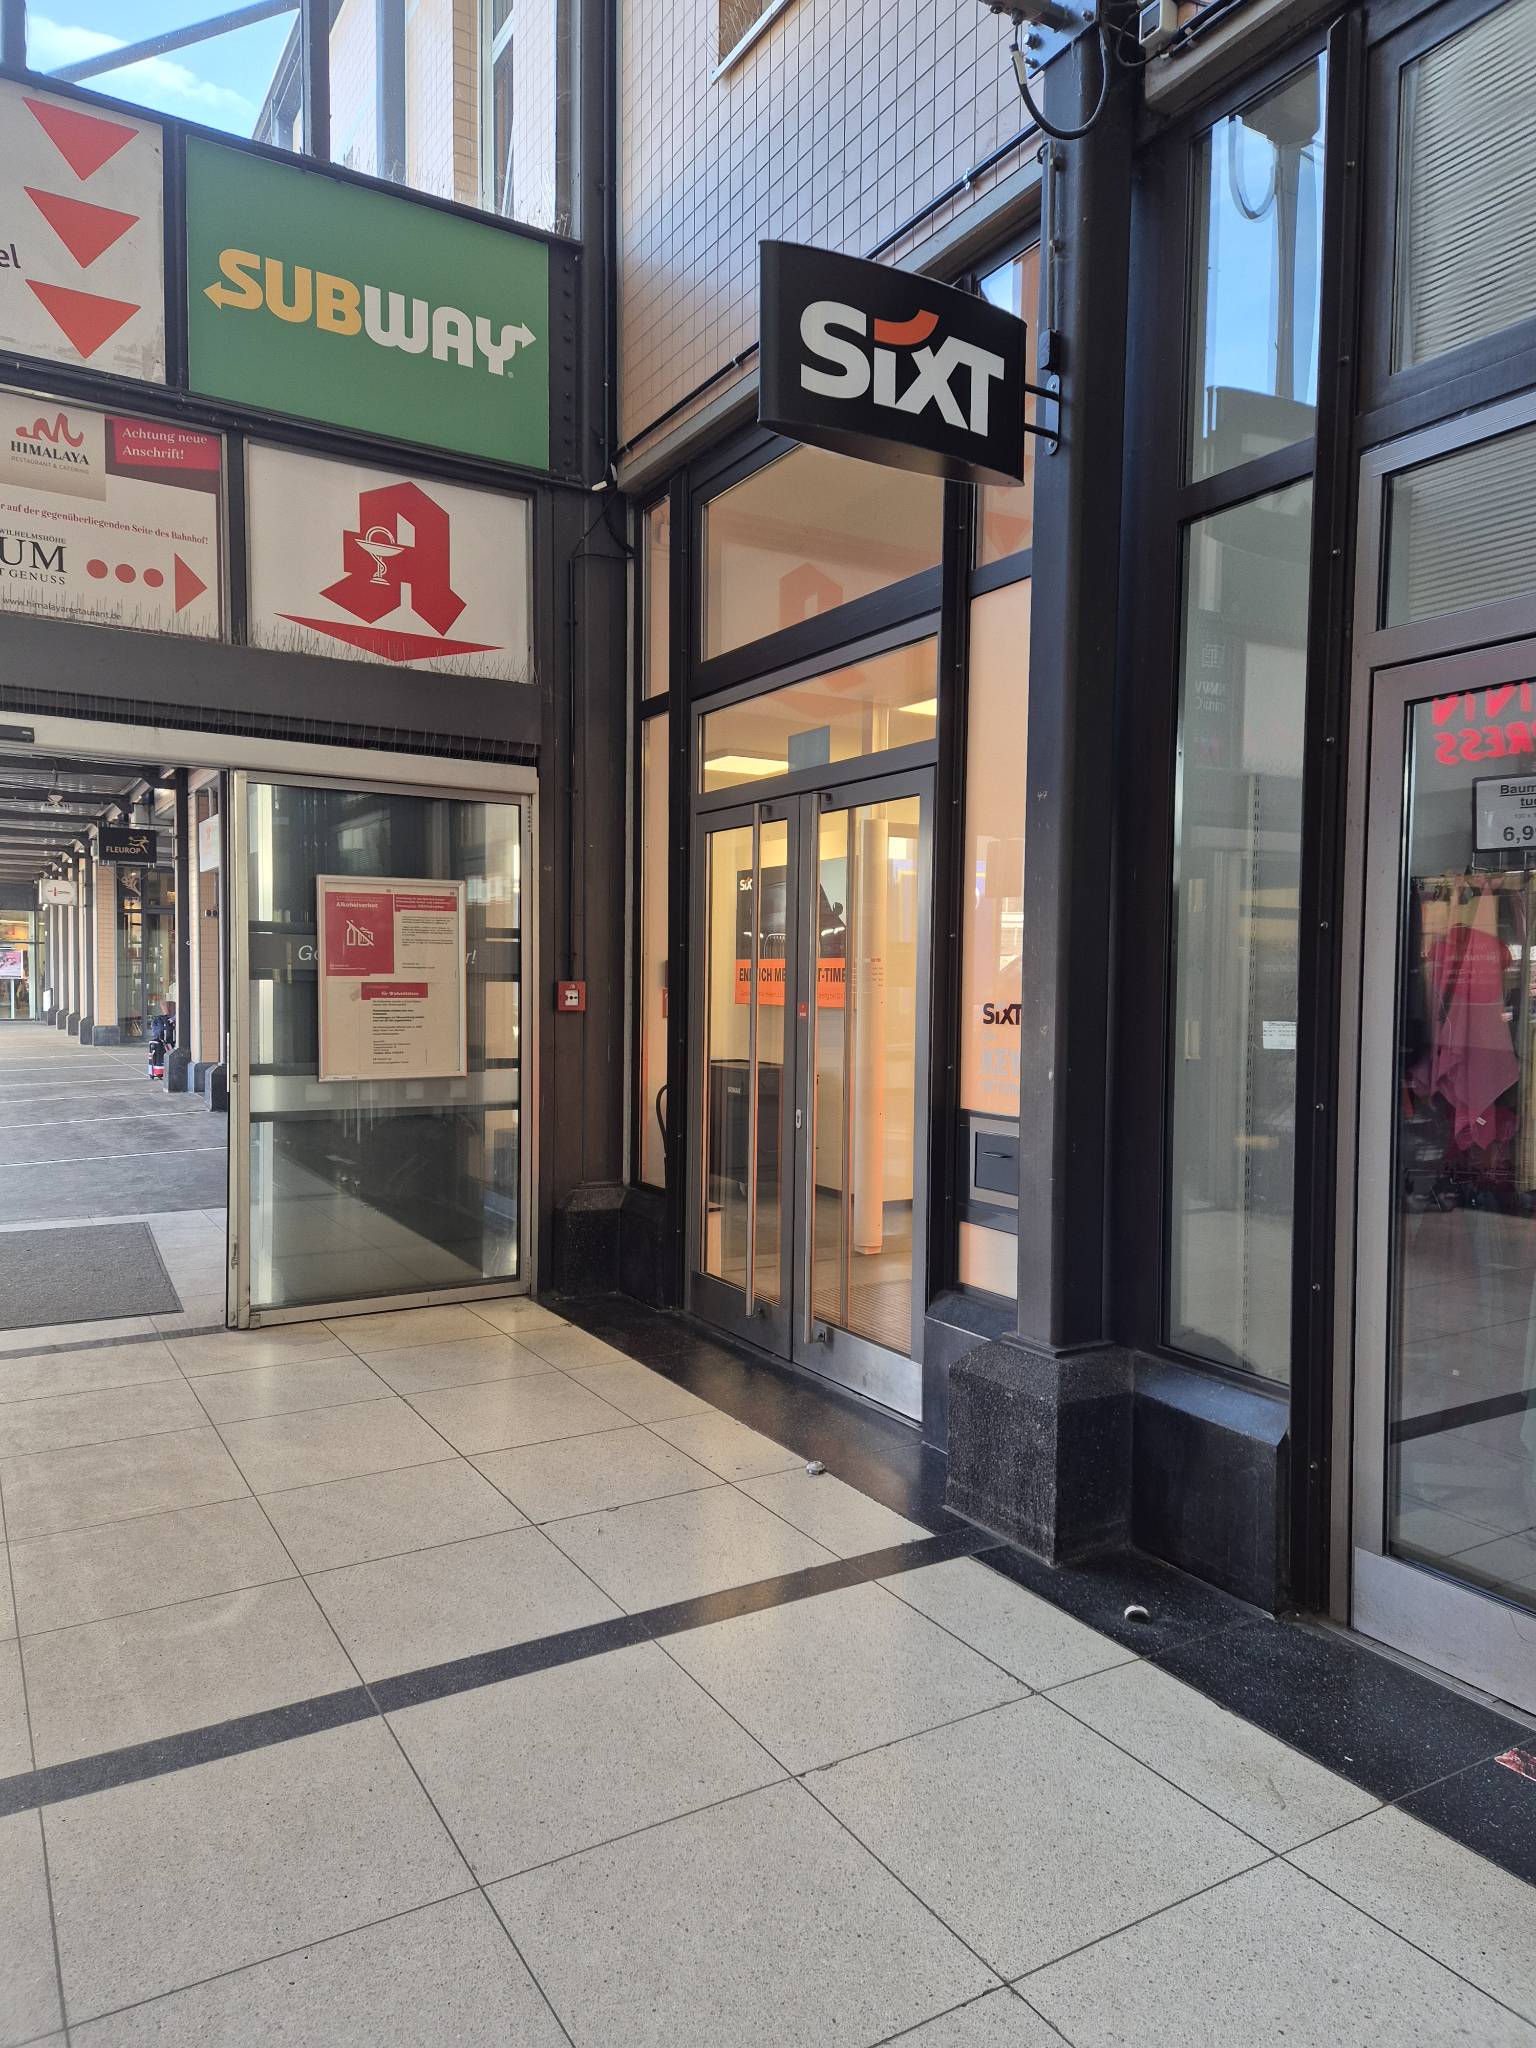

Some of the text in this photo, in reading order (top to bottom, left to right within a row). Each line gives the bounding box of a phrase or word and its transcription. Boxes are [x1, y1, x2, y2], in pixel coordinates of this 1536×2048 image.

[203, 248, 537, 376] SUBWAY
[800, 300, 1005, 437] SIXT
[122, 428, 208, 444] Achtung neue
[11, 440, 90, 466] HIMALAYA
[122, 445, 184, 460] Anschrift!
[7, 504, 22, 513] auf
[24, 505, 40, 515] der
[41, 508, 130, 531] gegenüberliegenden
[131, 523, 153, 535] Seite
[154, 528, 170, 538] des
[171, 530, 209, 545] Bahnhof!
[0, 536, 68, 574] UM
[9, 568, 66, 585] GENUSS
[1503, 824, 1536, 844] 6,9
[105, 845, 141, 854] FLEUROP
[740, 877, 753, 892] SIX
[739, 967, 773, 982] ENICH
